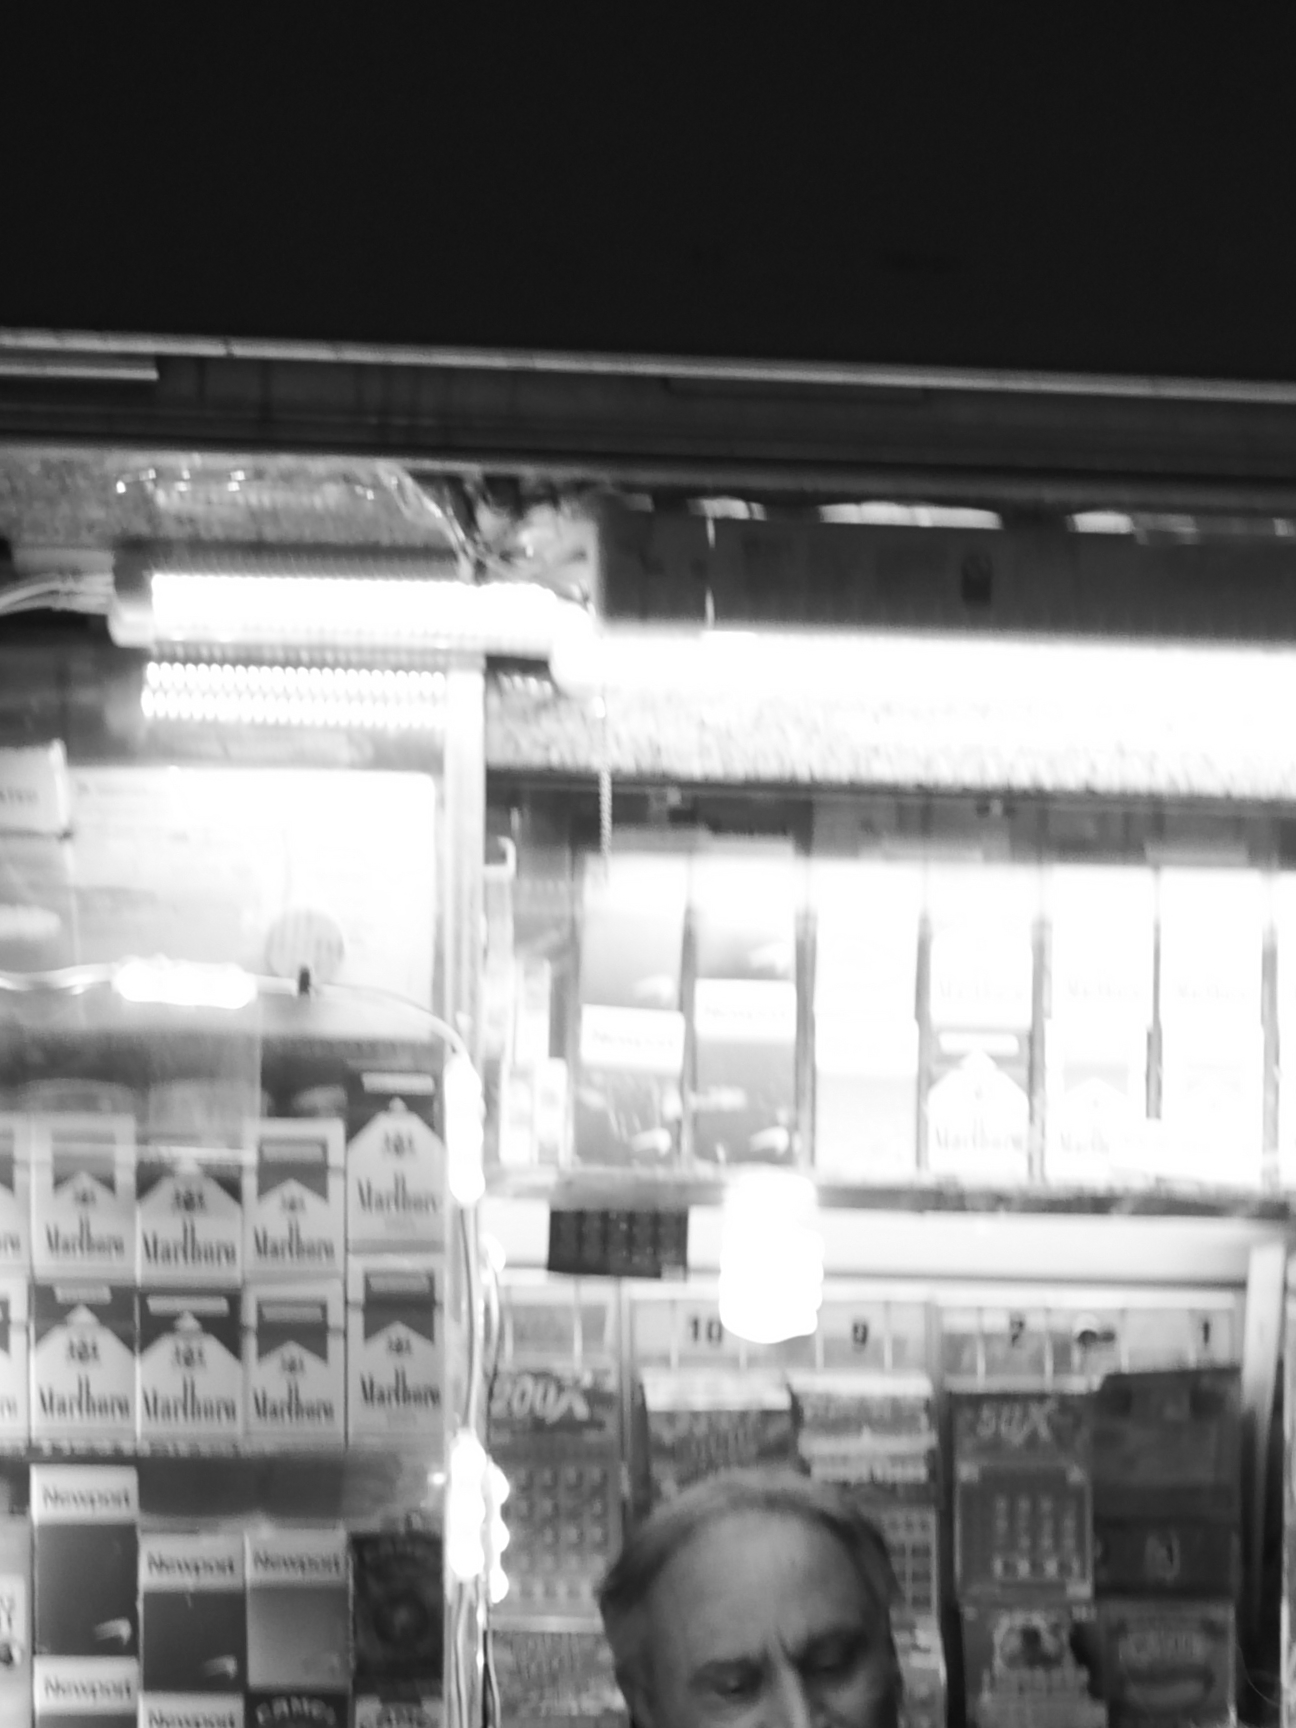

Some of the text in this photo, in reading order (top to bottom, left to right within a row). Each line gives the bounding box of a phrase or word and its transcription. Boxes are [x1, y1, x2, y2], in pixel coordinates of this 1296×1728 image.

[143, 1218, 237, 1265] Marlboro
[254, 1218, 335, 1259] Marlboro
[39, 1374, 131, 1420] Marlboro
[143, 1375, 237, 1422] Marlboro
[254, 1380, 335, 1423] Marlboro
[42, 1484, 131, 1509] Newport
[148, 1552, 235, 1576] Newport
[44, 1674, 132, 1700] Newport
